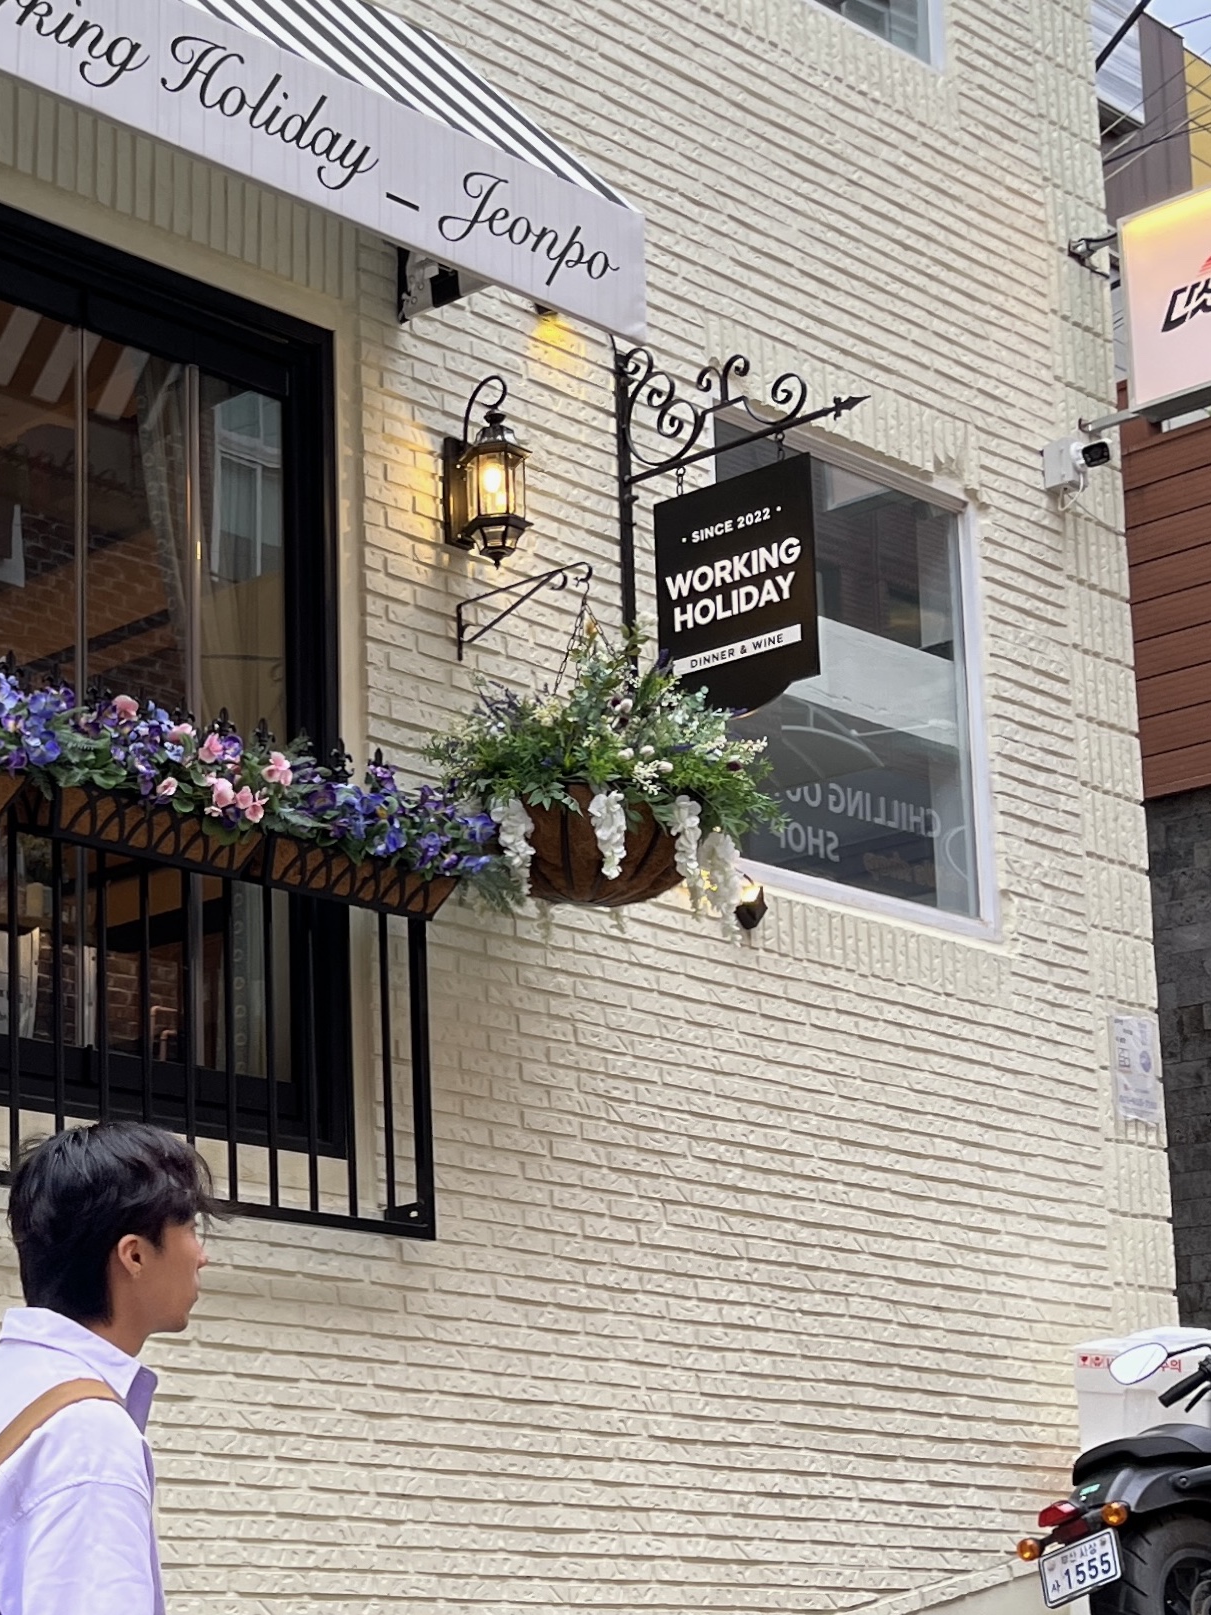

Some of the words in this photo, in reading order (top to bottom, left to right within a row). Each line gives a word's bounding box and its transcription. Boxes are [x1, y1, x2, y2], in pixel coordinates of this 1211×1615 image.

[160, 35, 380, 190] Holiday
[438, 172, 620, 286] Jeonpo
[691, 519, 734, 543] SINCE
[736, 507, 771, 530] 2022
[665, 536, 802, 601] WORKING
[673, 571, 796, 633] HOLIDAY
[690, 647, 735, 669] DINNER
[739, 644, 748, 655] &
[752, 633, 784, 651] WINE
[1051, 1580, 1061, 1594] 사
[1064, 1552, 1111, 1590] 1555
